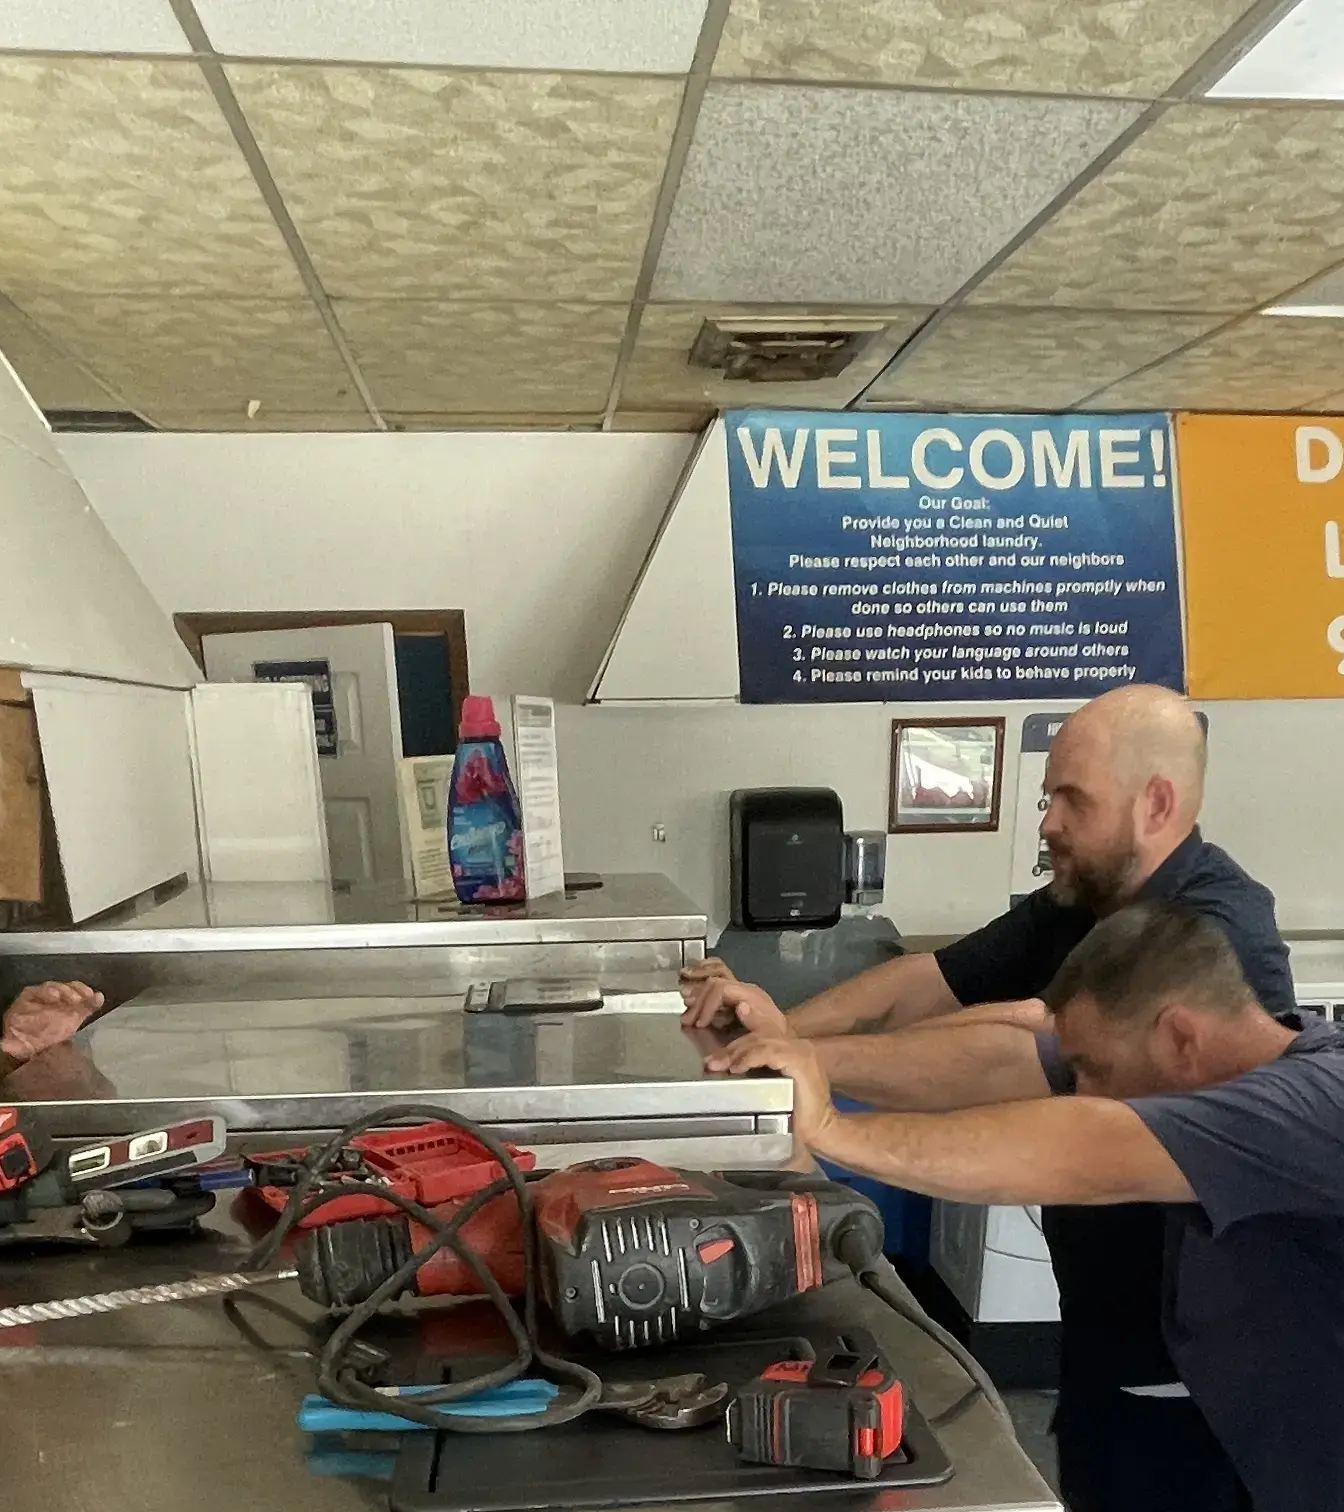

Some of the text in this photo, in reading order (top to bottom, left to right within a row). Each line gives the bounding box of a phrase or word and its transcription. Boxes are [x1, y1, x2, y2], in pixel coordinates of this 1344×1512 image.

[737, 427, 1167, 490] WELCOME!
[918, 495, 990, 511] Our Goal:
[842, 513, 1069, 533] Provide you a Clean and Quiet
[870, 533, 1043, 552] Neighborhood laundry.
[789, 552, 1125, 571] Please respect each other and our neighbors
[752, 578, 1166, 598] 1. Please remove clothes from machines promptly when
[851, 599, 1068, 615] done so others can use them
[783, 620, 1129, 641] 2. Please use headphones so no music is loud
[793, 643, 1129, 663] 3. Please watch your language around others
[793, 663, 1137, 685] 4. Please remind your kids to behave properly
